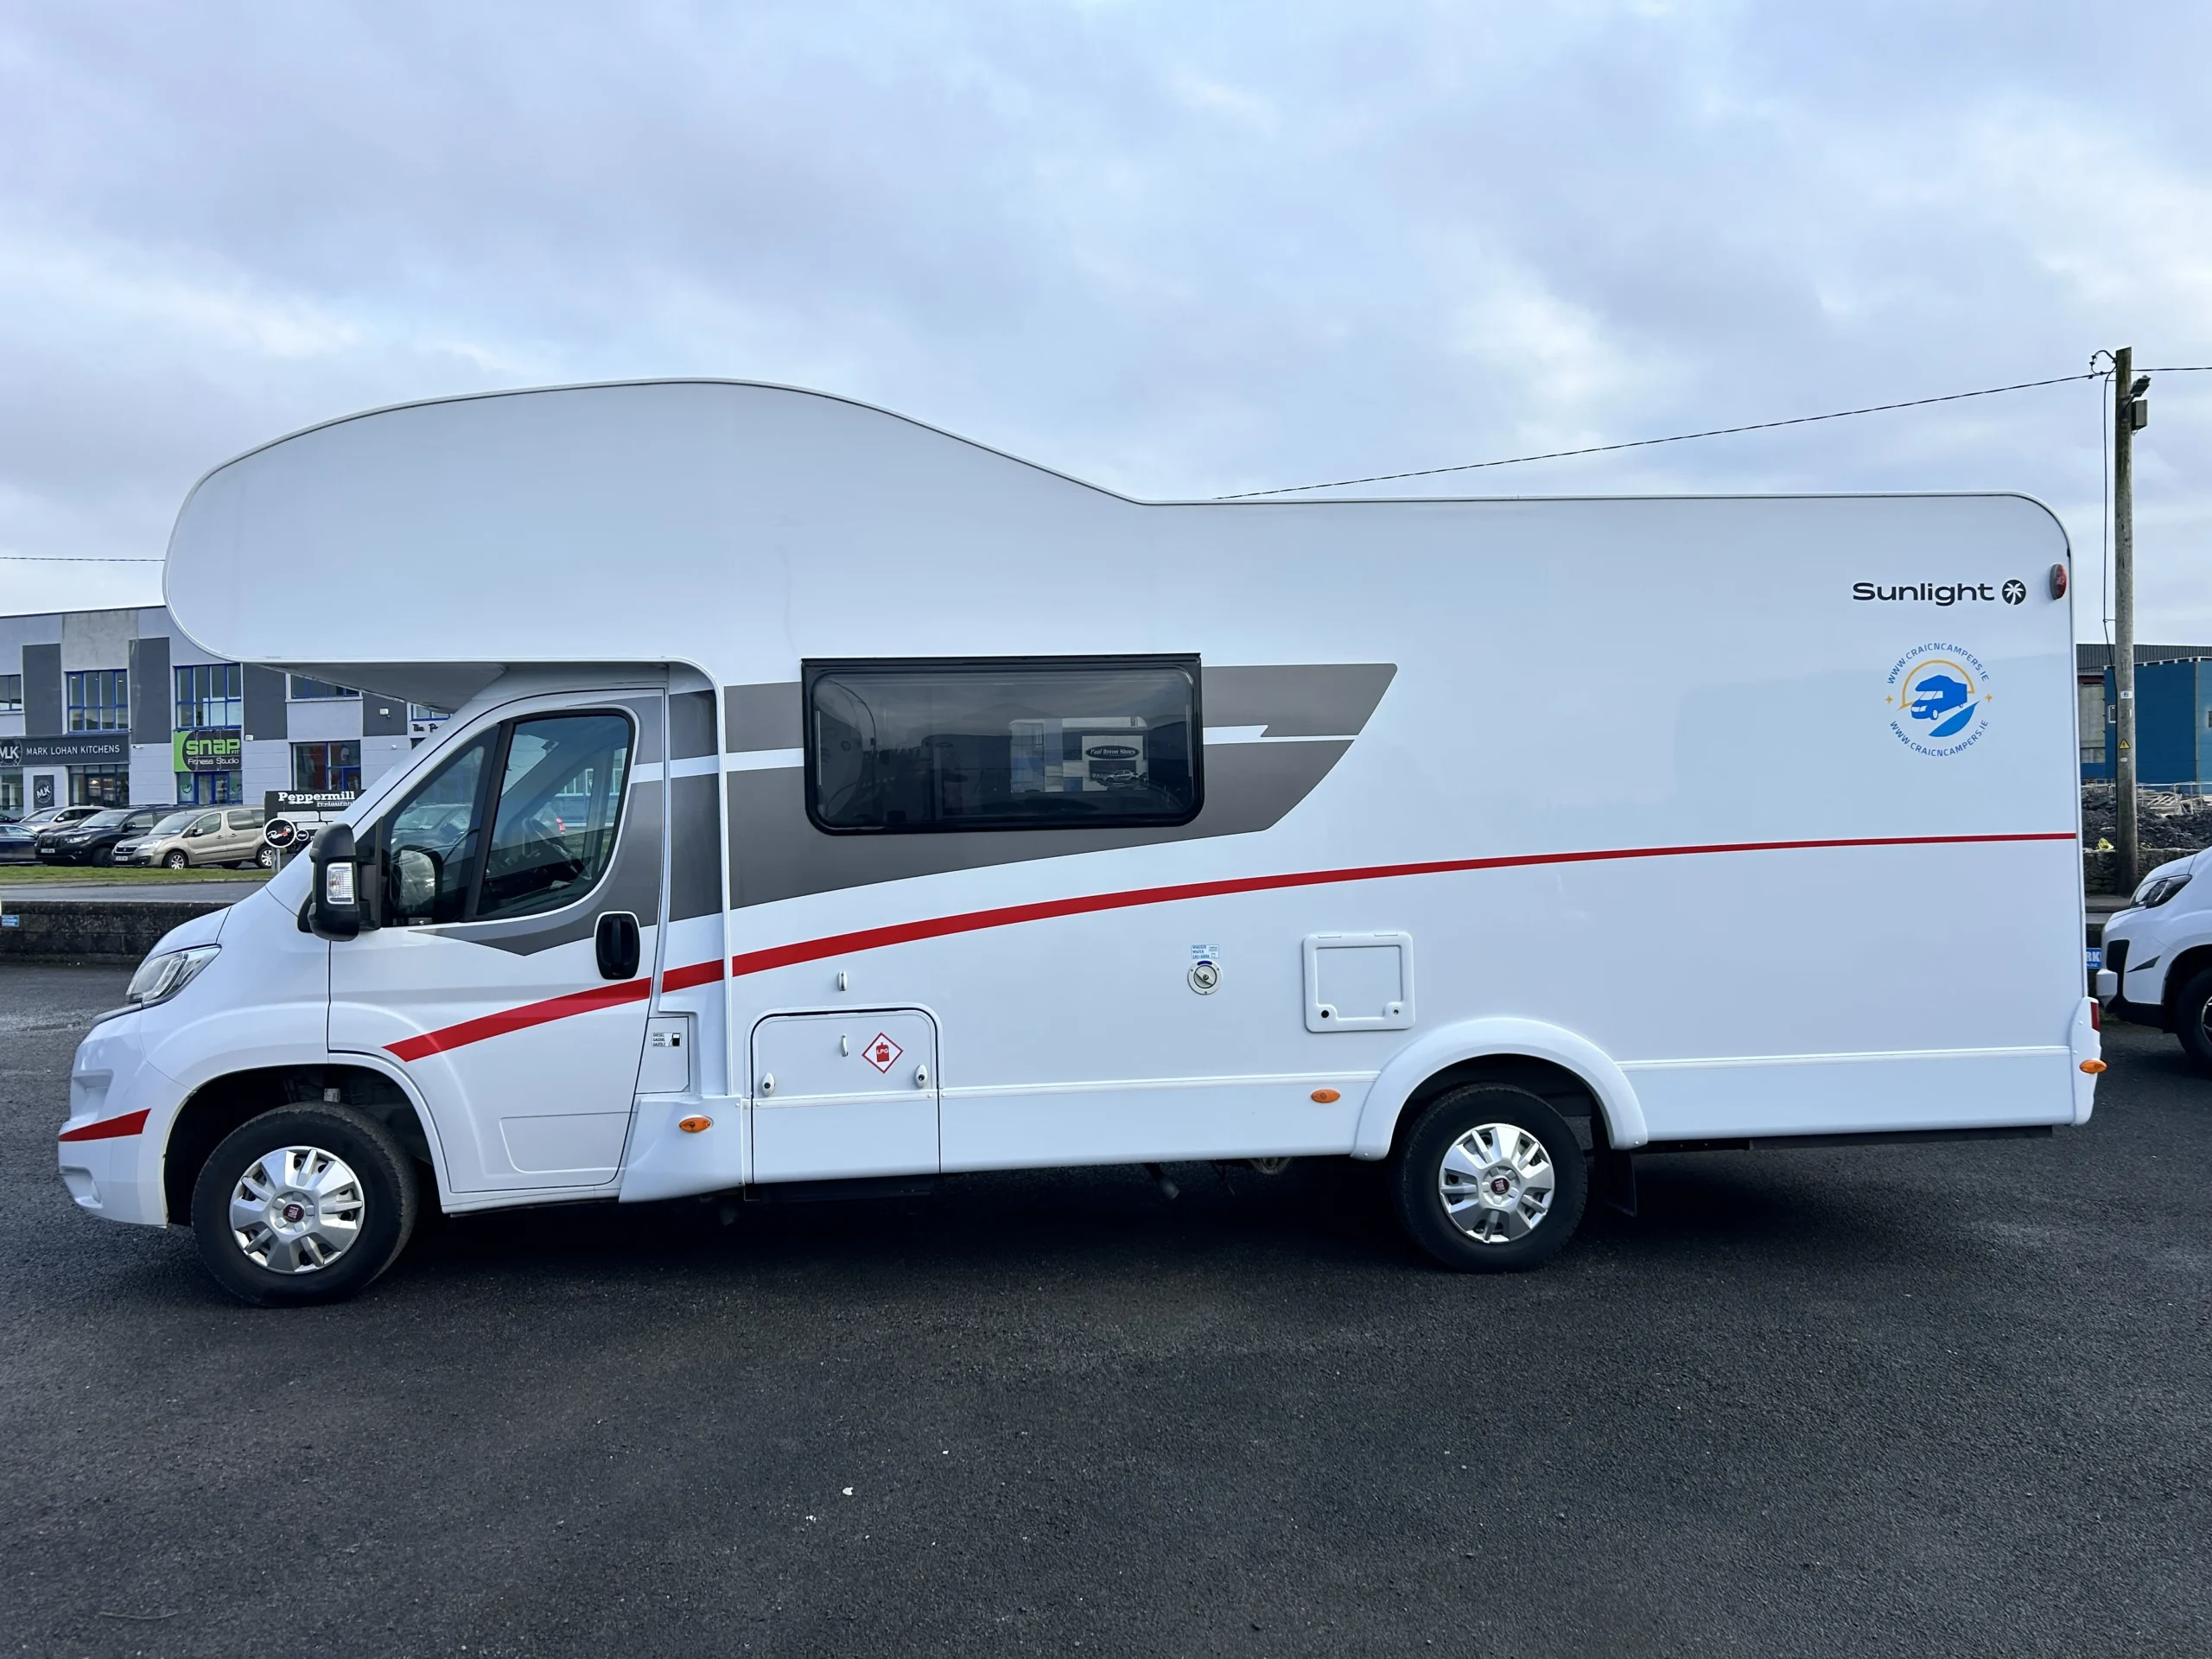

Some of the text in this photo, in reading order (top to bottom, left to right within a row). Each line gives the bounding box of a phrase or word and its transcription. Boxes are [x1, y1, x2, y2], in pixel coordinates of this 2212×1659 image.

[1853, 582, 1995, 607] Sunlight
[1887, 642, 1990, 684] WWW.CRAICNCAMPERS.IE
[1890, 719, 1988, 757] WWW.CRAICNCAMPERS.IE
[26, 744, 120, 756] MARK LOHAN KITCHENS
[36, 785, 51, 798] MLK
[278, 791, 355, 804] Peppermill
